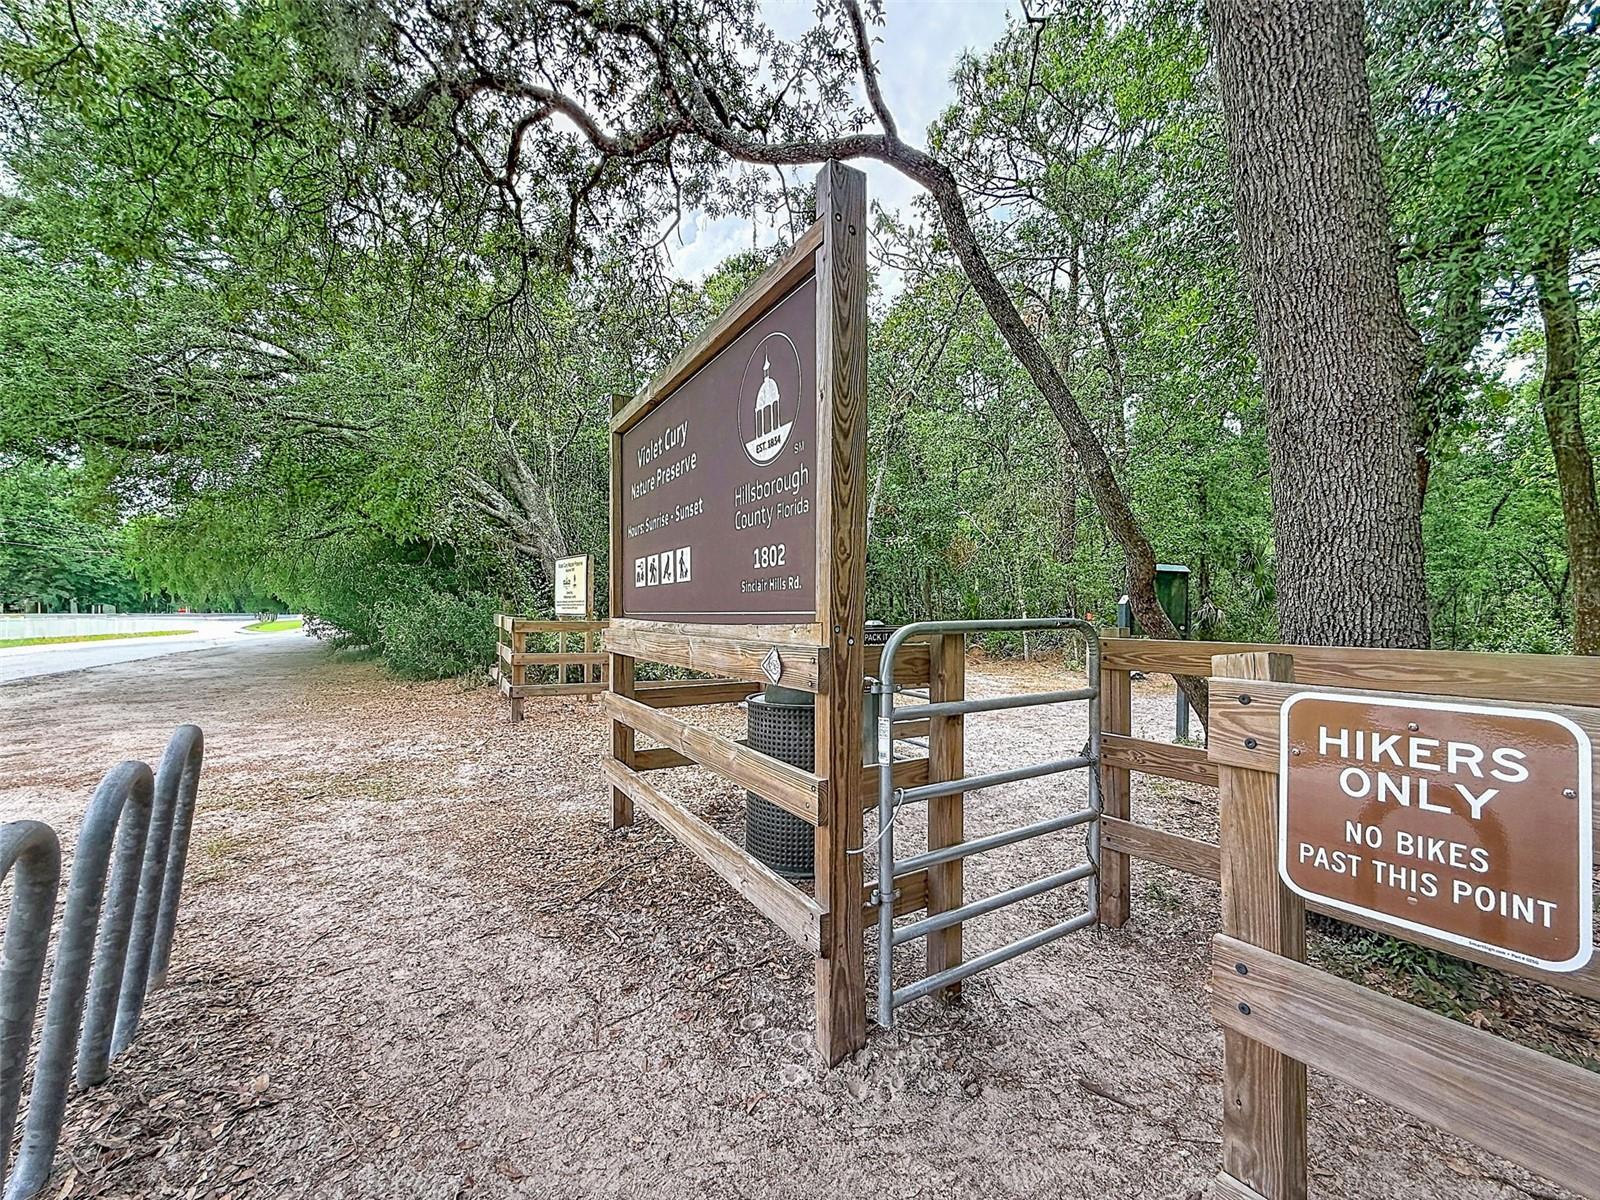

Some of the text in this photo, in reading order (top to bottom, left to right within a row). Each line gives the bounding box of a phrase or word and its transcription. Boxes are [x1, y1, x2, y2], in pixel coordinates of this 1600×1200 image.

[637, 420, 689, 468] Violet Cury
[756, 435, 781, 454] EST. 1834
[631, 452, 697, 500] Nature Preserve
[734, 463, 809, 507] Hillsborough
[645, 511, 669, 533] Sunrise
[675, 497, 704, 521] Sunset
[735, 497, 809, 530] County Florida
[753, 544, 786, 569] 1802
[741, 575, 802, 593] Sinclair Hills Rd.
[864, 633, 881, 641] PACK
[1319, 726, 1529, 783] HIKERS
[1339, 767, 1499, 820] ONLY
[1345, 820, 1489, 873] NO BIKES
[1299, 843, 1557, 928] PAST THIS POINT
